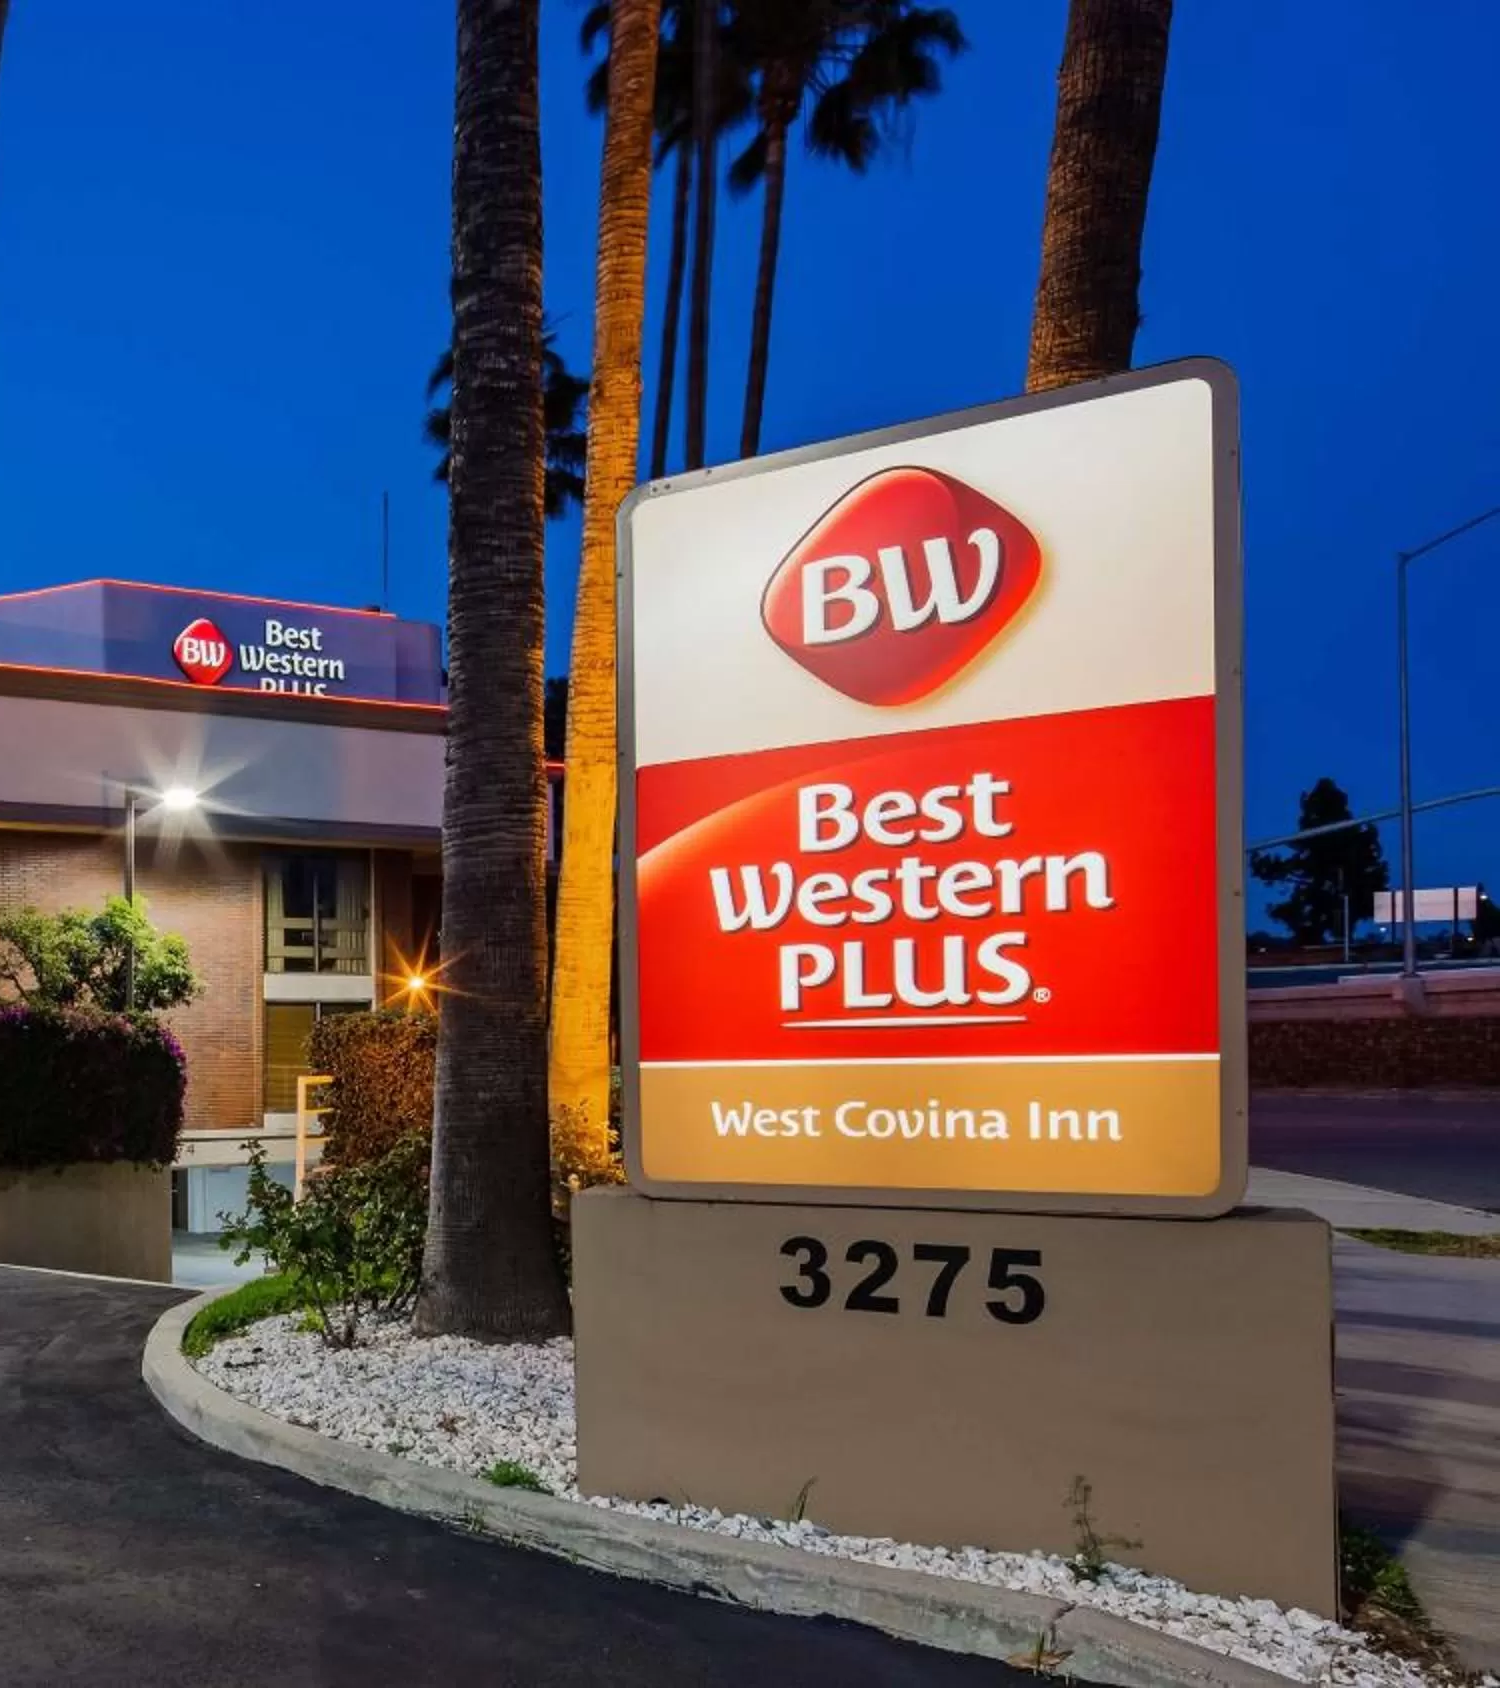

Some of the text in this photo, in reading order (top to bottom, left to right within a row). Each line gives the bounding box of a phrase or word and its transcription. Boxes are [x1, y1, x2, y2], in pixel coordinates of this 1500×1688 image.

[801, 527, 1000, 646] BW
[182, 637, 225, 667] BW
[239, 644, 345, 680] Western
[265, 619, 322, 651] Best
[798, 773, 1012, 853] Best
[710, 850, 1114, 932] Western
[711, 1100, 1121, 1140] West Covina Inn
[779, 1235, 1046, 1325] 3275
